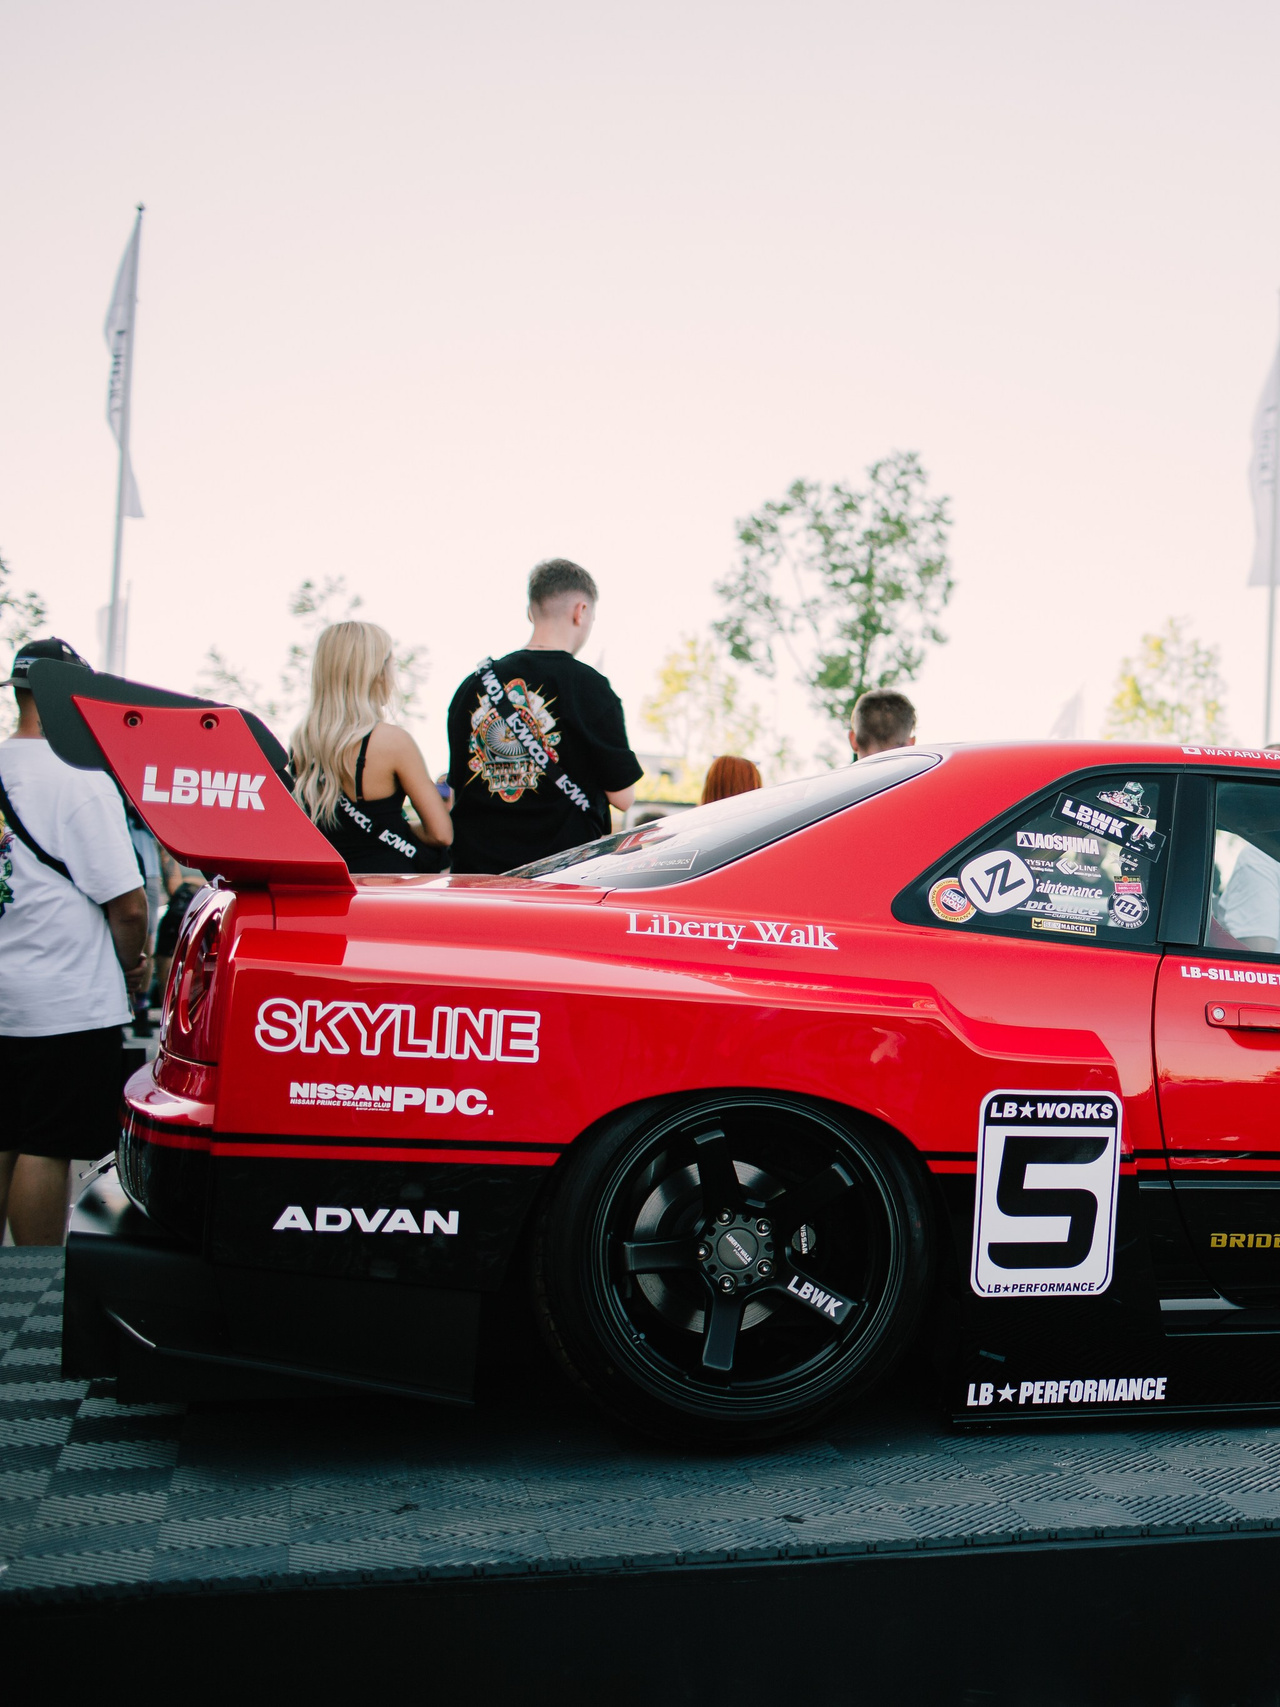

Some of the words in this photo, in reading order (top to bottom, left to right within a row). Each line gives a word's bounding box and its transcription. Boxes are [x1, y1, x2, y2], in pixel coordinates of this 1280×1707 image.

[1203, 748, 1261, 759] WATARU
[141, 765, 267, 811] LBWK
[1061, 799, 1127, 838] LBWK
[1035, 833, 1100, 855] AOSHIMA
[1035, 878, 1103, 899] aintenance
[625, 912, 746, 950] Liberty
[749, 919, 839, 951] Walk
[254, 997, 541, 1064] SKYLINE
[272, 1205, 460, 1236] ADVAN
[987, 1135, 1109, 1269] 5
[786, 1274, 844, 1318] LBWK
